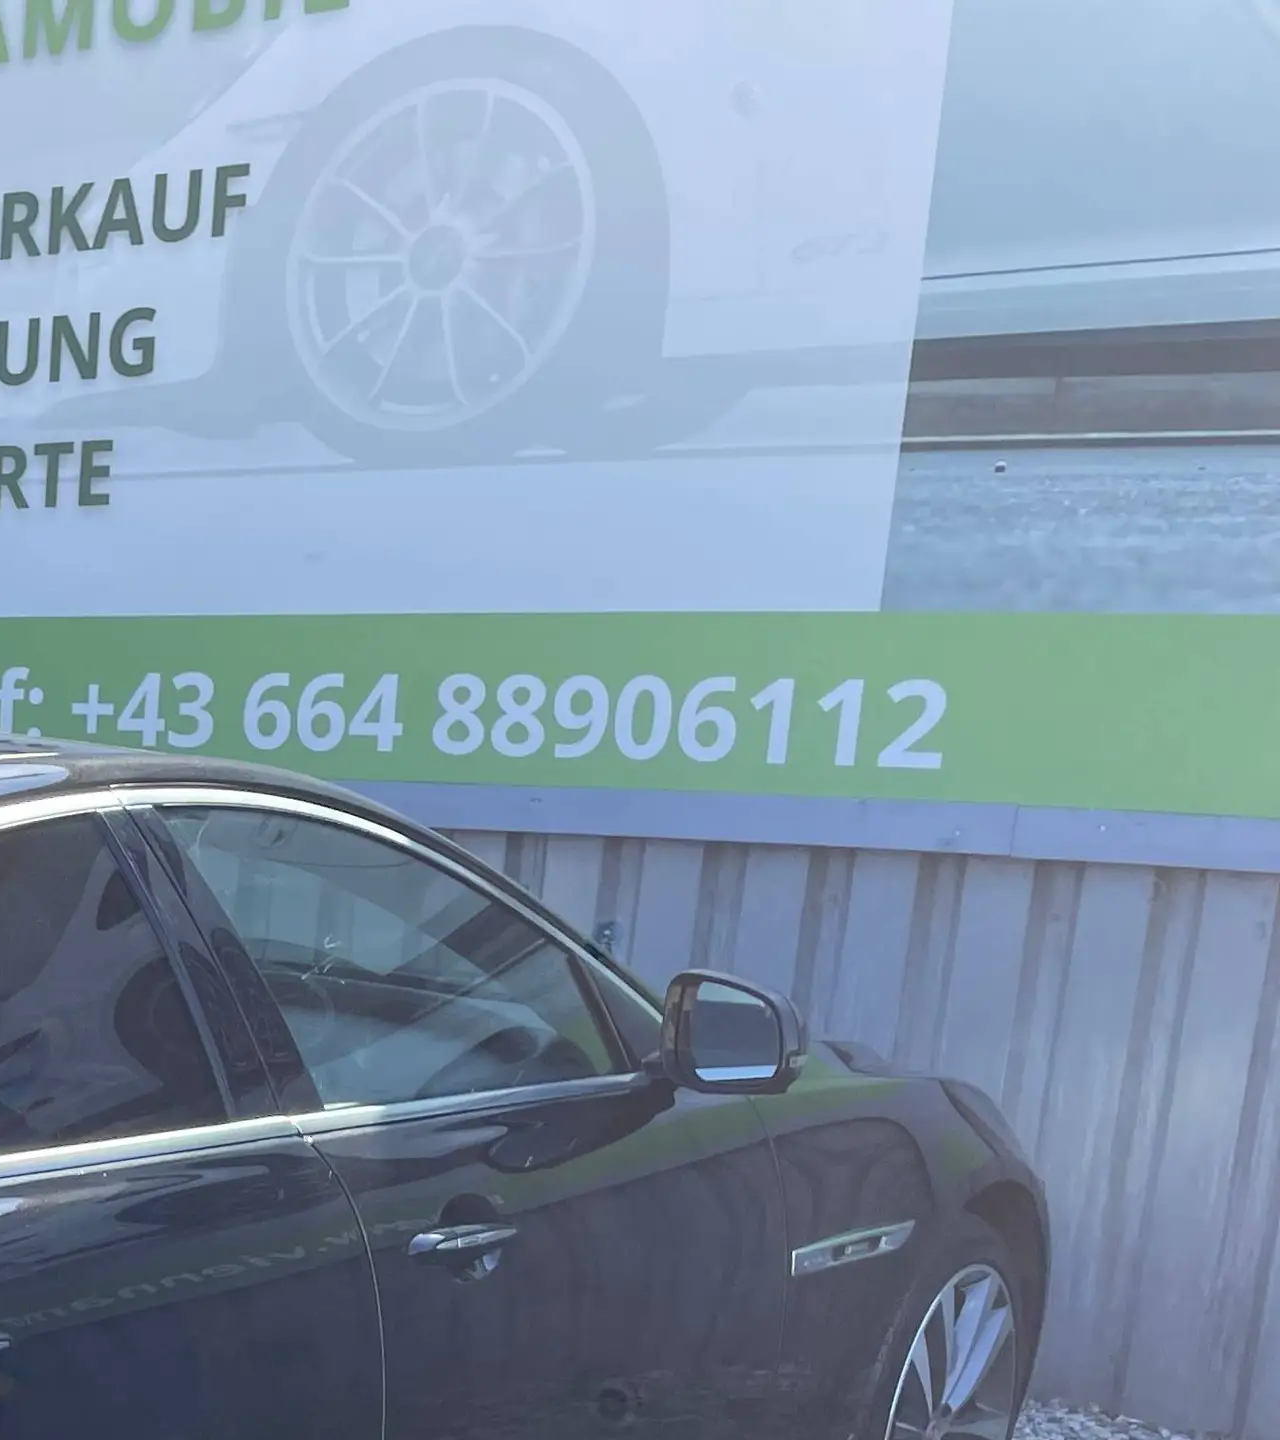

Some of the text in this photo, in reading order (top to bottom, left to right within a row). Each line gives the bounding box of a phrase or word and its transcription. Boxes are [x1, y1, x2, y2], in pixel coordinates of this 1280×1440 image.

[70, 671, 216, 747] +43
[242, 672, 403, 753] 664
[430, 672, 950, 771] 88906112
